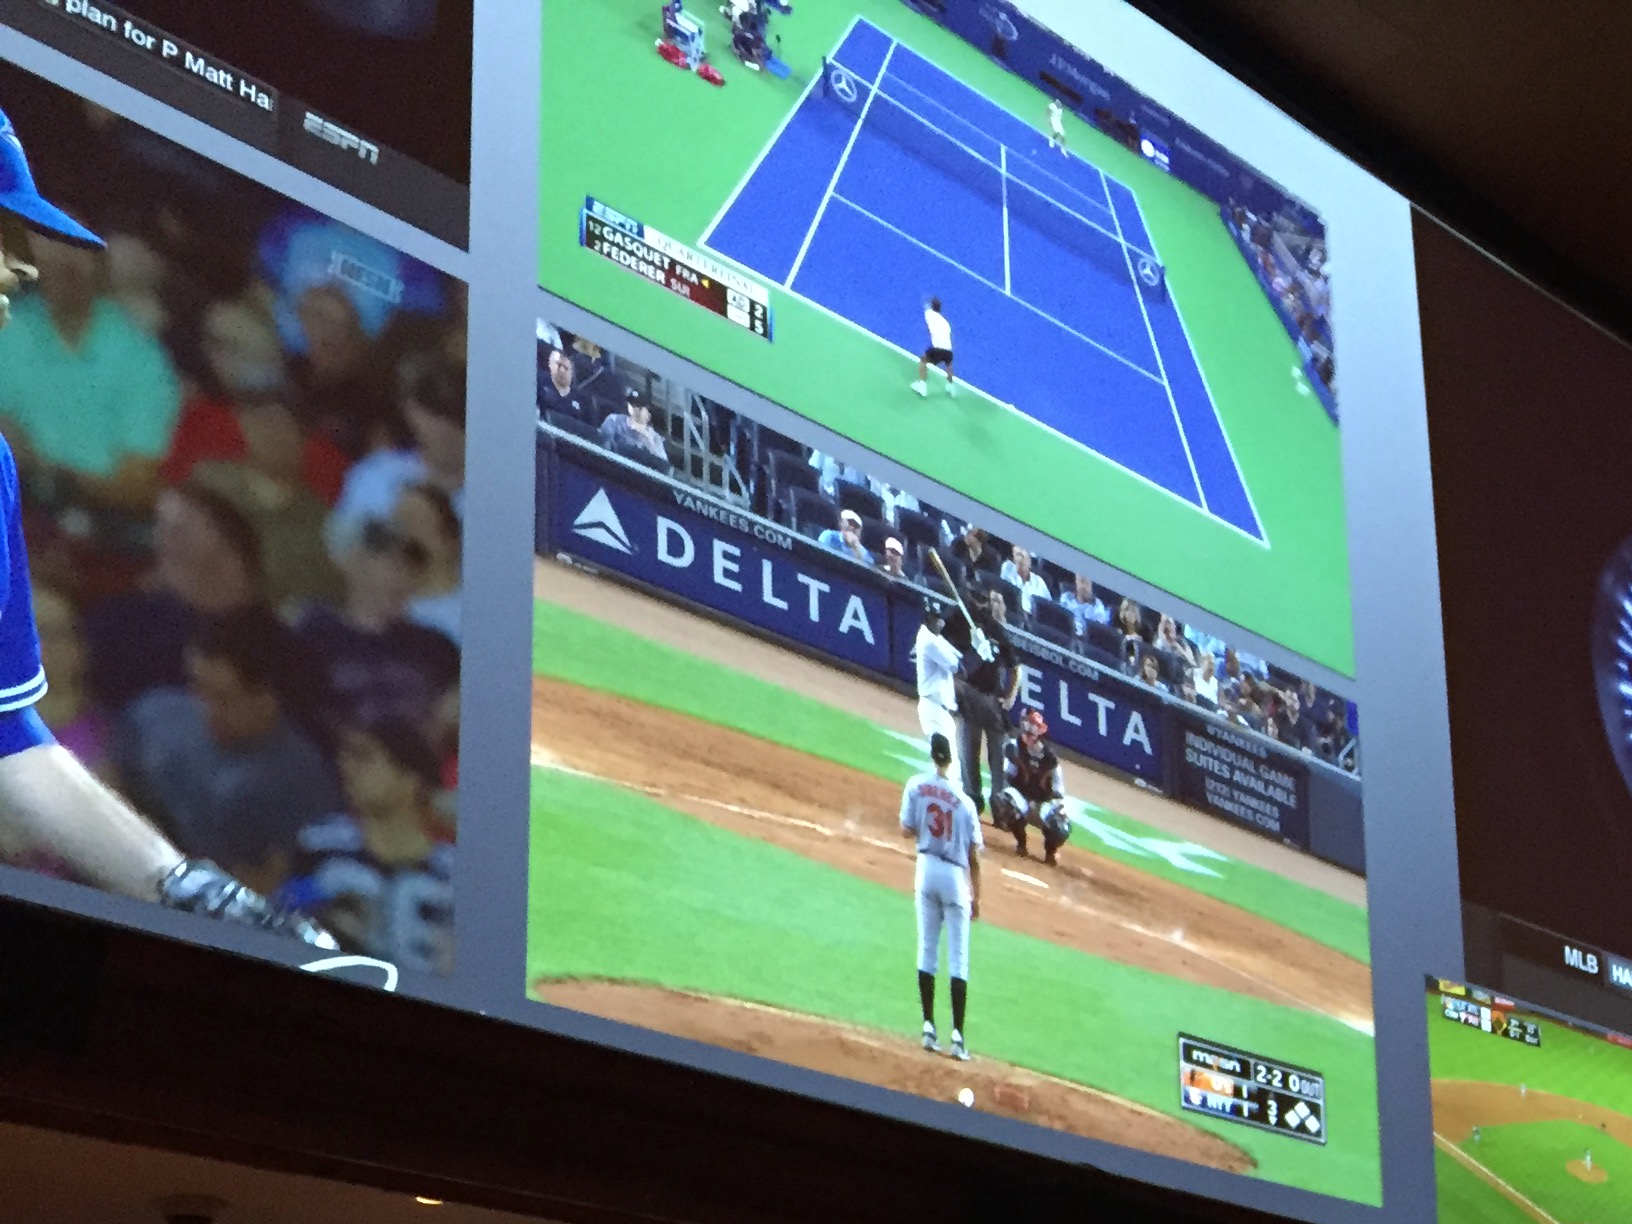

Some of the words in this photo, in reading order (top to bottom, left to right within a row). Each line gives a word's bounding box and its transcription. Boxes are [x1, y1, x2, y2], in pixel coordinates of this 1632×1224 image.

[64, 0, 118, 33] plan
[124, 19, 157, 51] for
[162, 40, 180, 61] P
[184, 51, 234, 92] Matt
[303, 111, 380, 165] ESPN
[602, 225, 670, 269] GASQUET
[675, 261, 699, 286] FRA
[603, 240, 666, 286] FEDERER
[655, 515, 875, 646] DELTA
[1015, 662, 1153, 756] ELTA
[926, 802, 953, 843] 31
[1564, 945, 1600, 974] MLB
